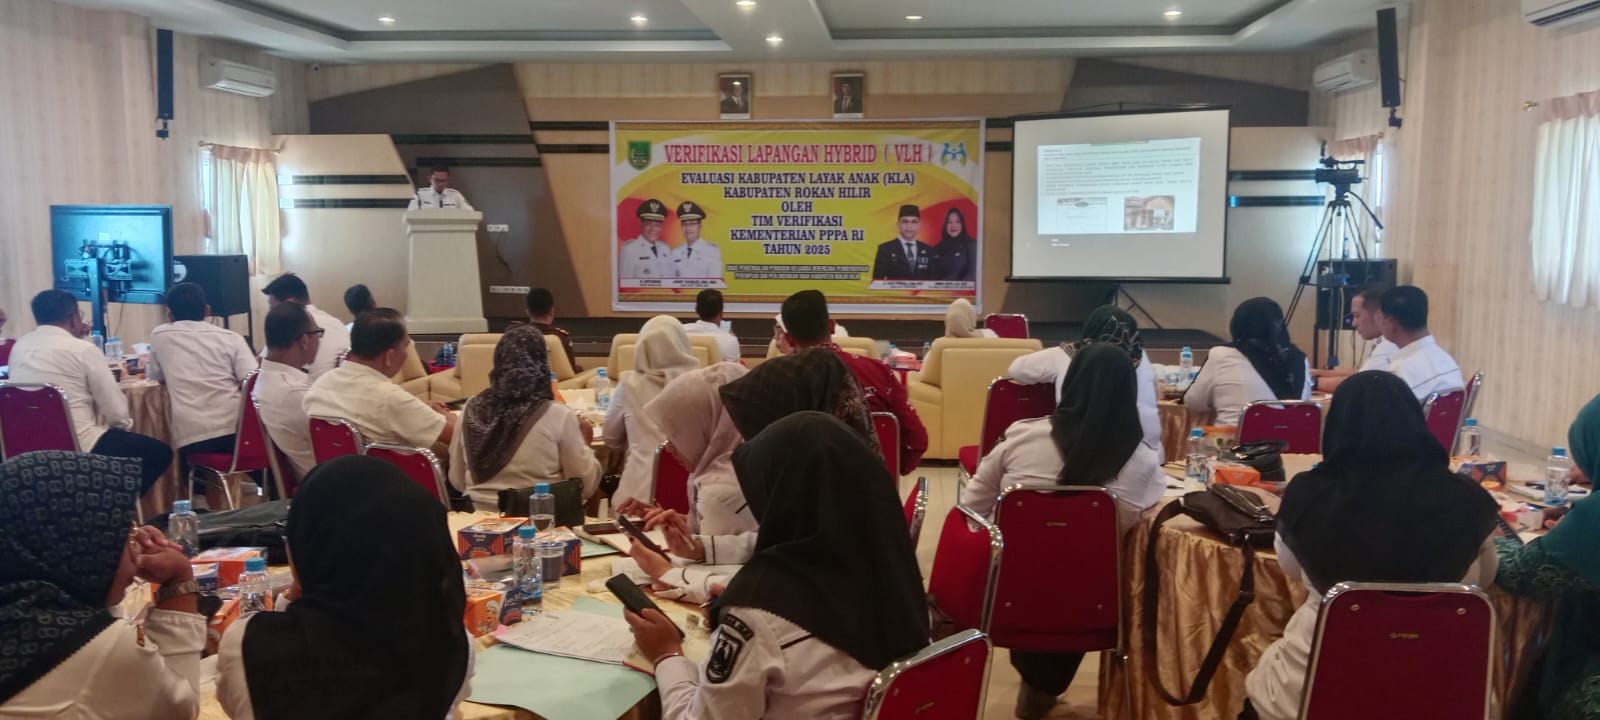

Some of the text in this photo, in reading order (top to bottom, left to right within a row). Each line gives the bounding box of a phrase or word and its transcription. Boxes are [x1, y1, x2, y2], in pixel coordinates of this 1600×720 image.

[664, 144, 743, 163] VERIFIKASI
[747, 144, 819, 163] LAPANGAN
[823, 144, 877, 163] HYBRID
[894, 144, 923, 163] VLH
[681, 172, 915, 186] EVALUASI KABUPATEN LAYAK ANAK (KLA)
[723, 187, 871, 198] KABUPATEN ROKAN HILIR
[781, 201, 813, 212] OLEH
[751, 215, 842, 226] TIM VERIFIKASI
[730, 229, 864, 240] KEMENTERIAN PPPA RI
[763, 243, 831, 254] TAHUN 2025
